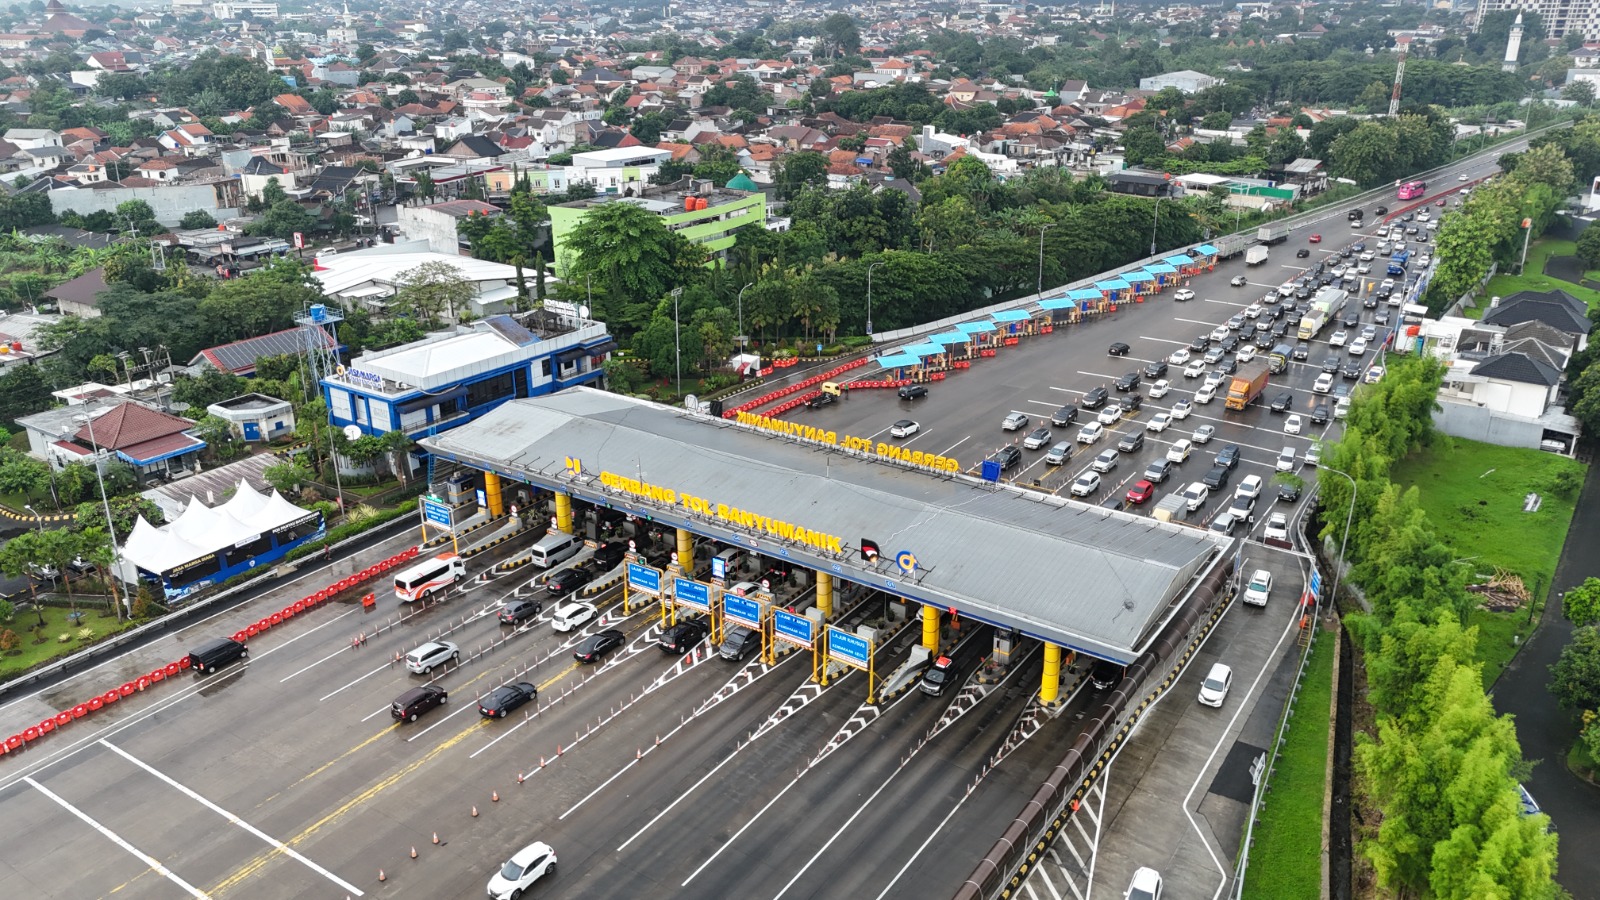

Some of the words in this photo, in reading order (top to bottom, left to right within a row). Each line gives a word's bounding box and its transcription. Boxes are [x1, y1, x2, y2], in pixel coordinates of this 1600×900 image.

[600, 471, 676, 503] GERBANG
[680, 493, 714, 515] TOL
[718, 503, 842, 553] BANYUMANIK
[832, 632, 847, 642] LAJUR
[847, 638, 866, 649] KHUSUS
